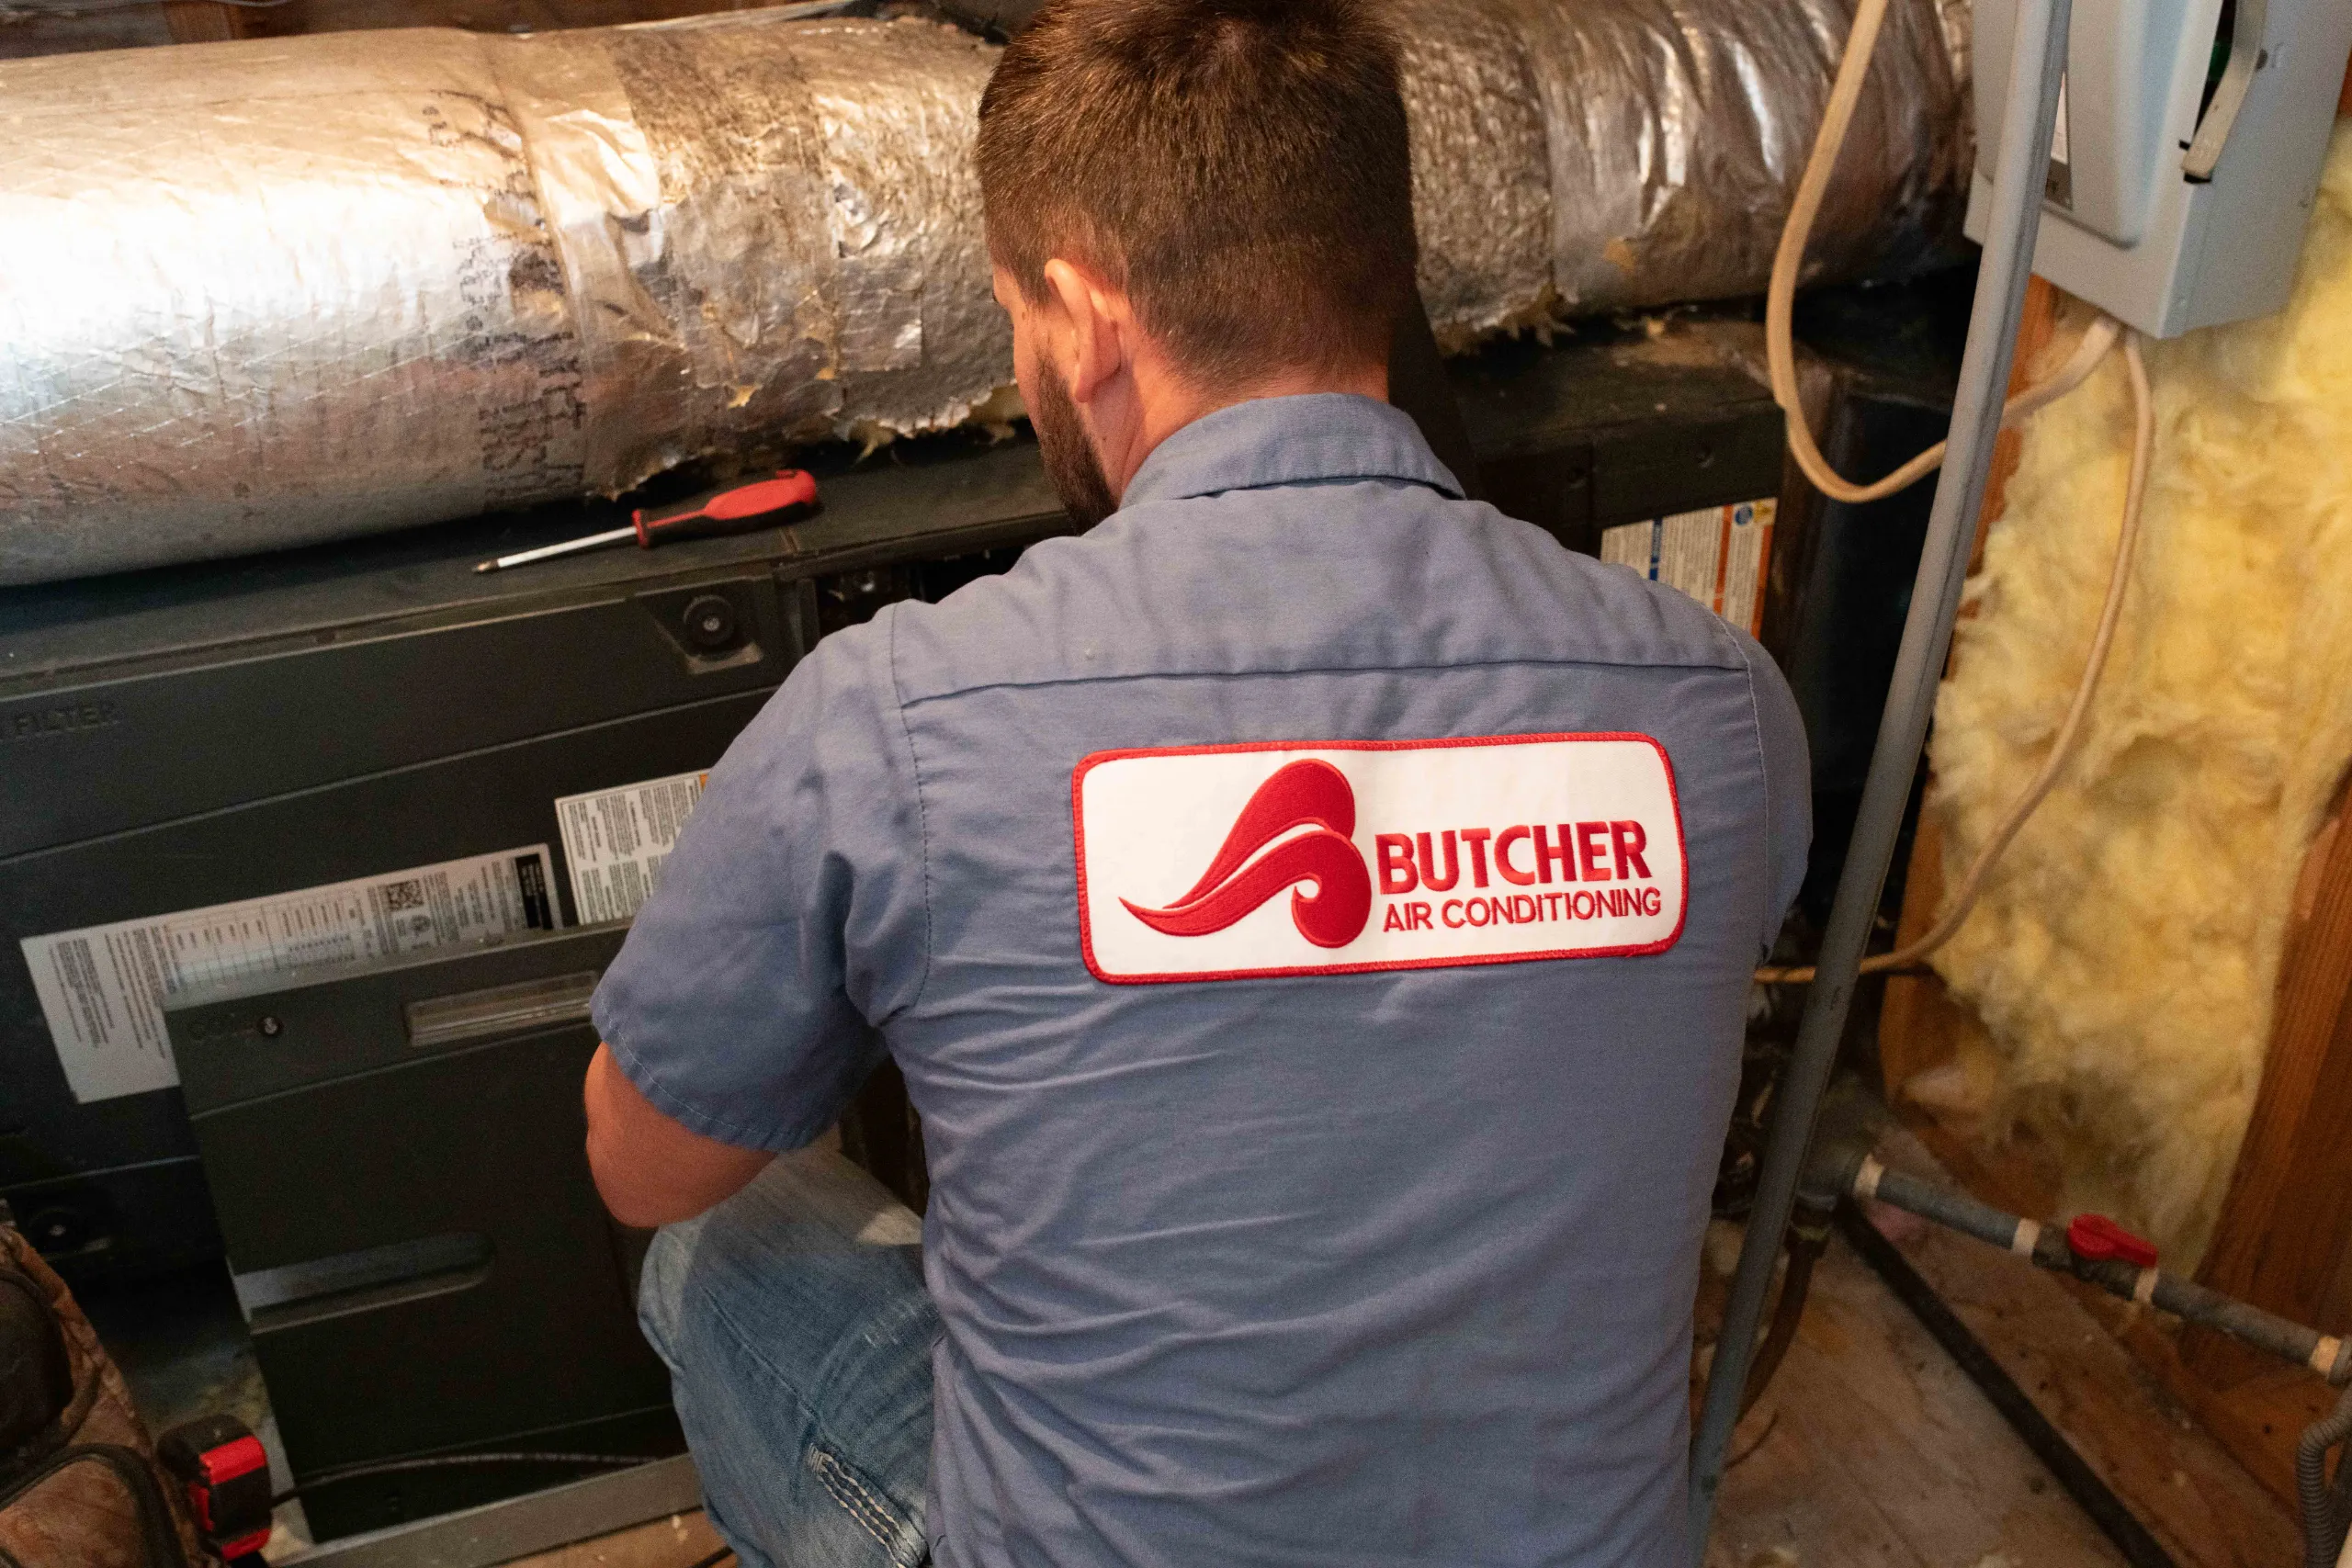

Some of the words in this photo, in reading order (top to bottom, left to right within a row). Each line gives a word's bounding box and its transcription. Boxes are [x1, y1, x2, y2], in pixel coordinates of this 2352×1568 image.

[1375, 820, 1652, 895] BUTCHER
[1383, 901, 1433, 932] AIR
[1441, 886, 1662, 929] CONDITIONING
